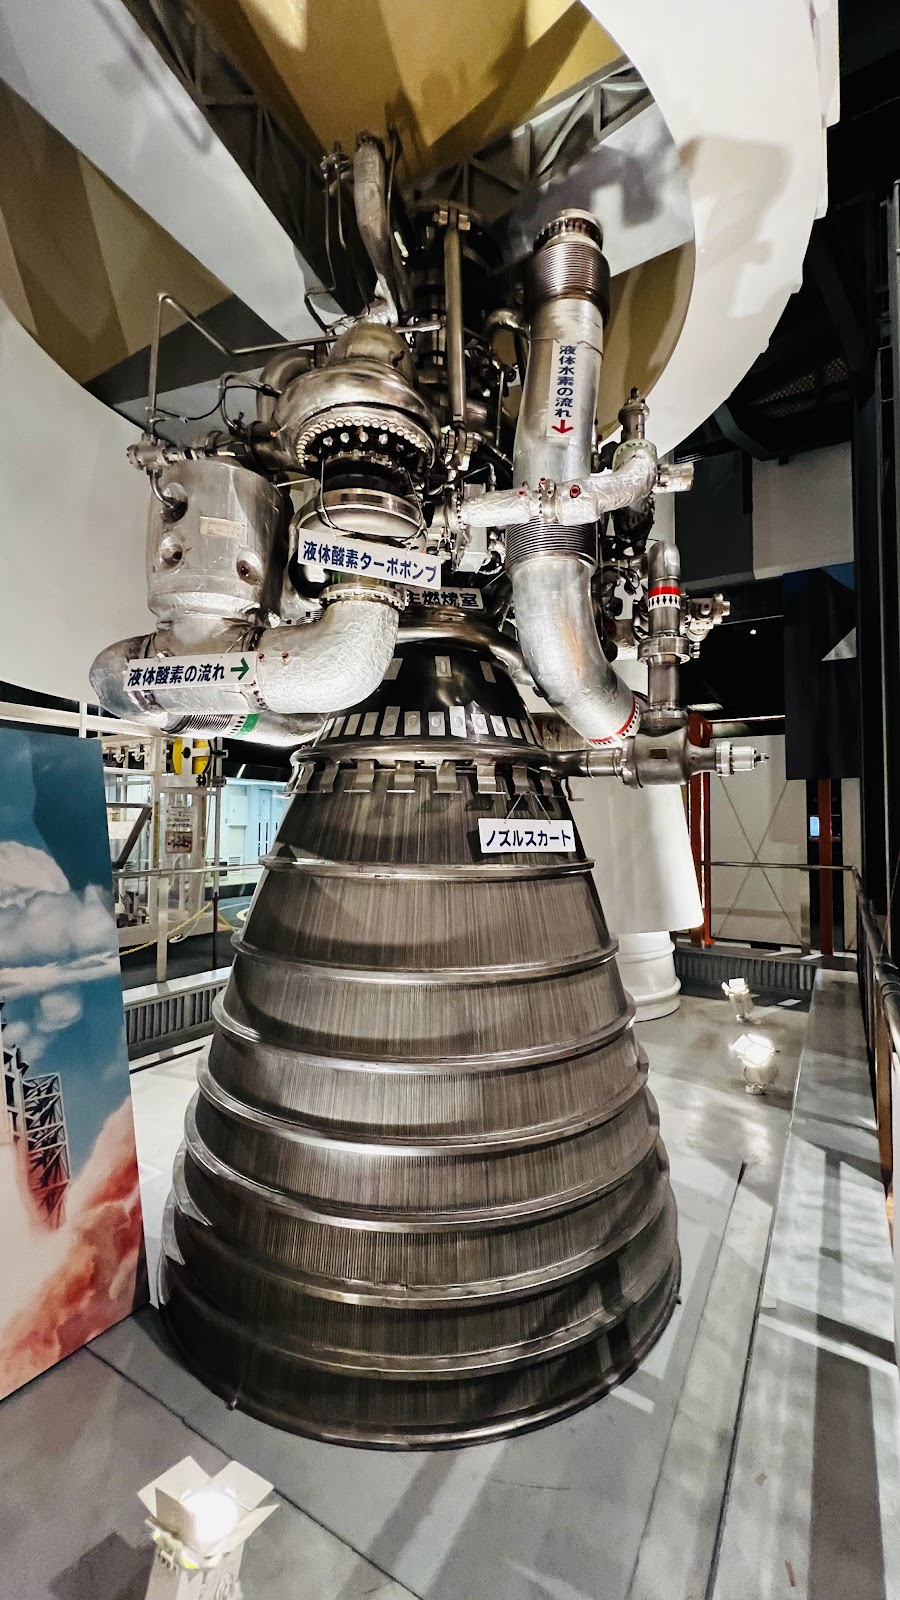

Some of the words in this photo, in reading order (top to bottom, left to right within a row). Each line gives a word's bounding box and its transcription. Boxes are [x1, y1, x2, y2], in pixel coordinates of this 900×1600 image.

[554, 345, 577, 417] 液体水素の流れ
[127, 663, 225, 687] 液体酸素の流れ
[486, 829, 571, 847] ノズルスカート
